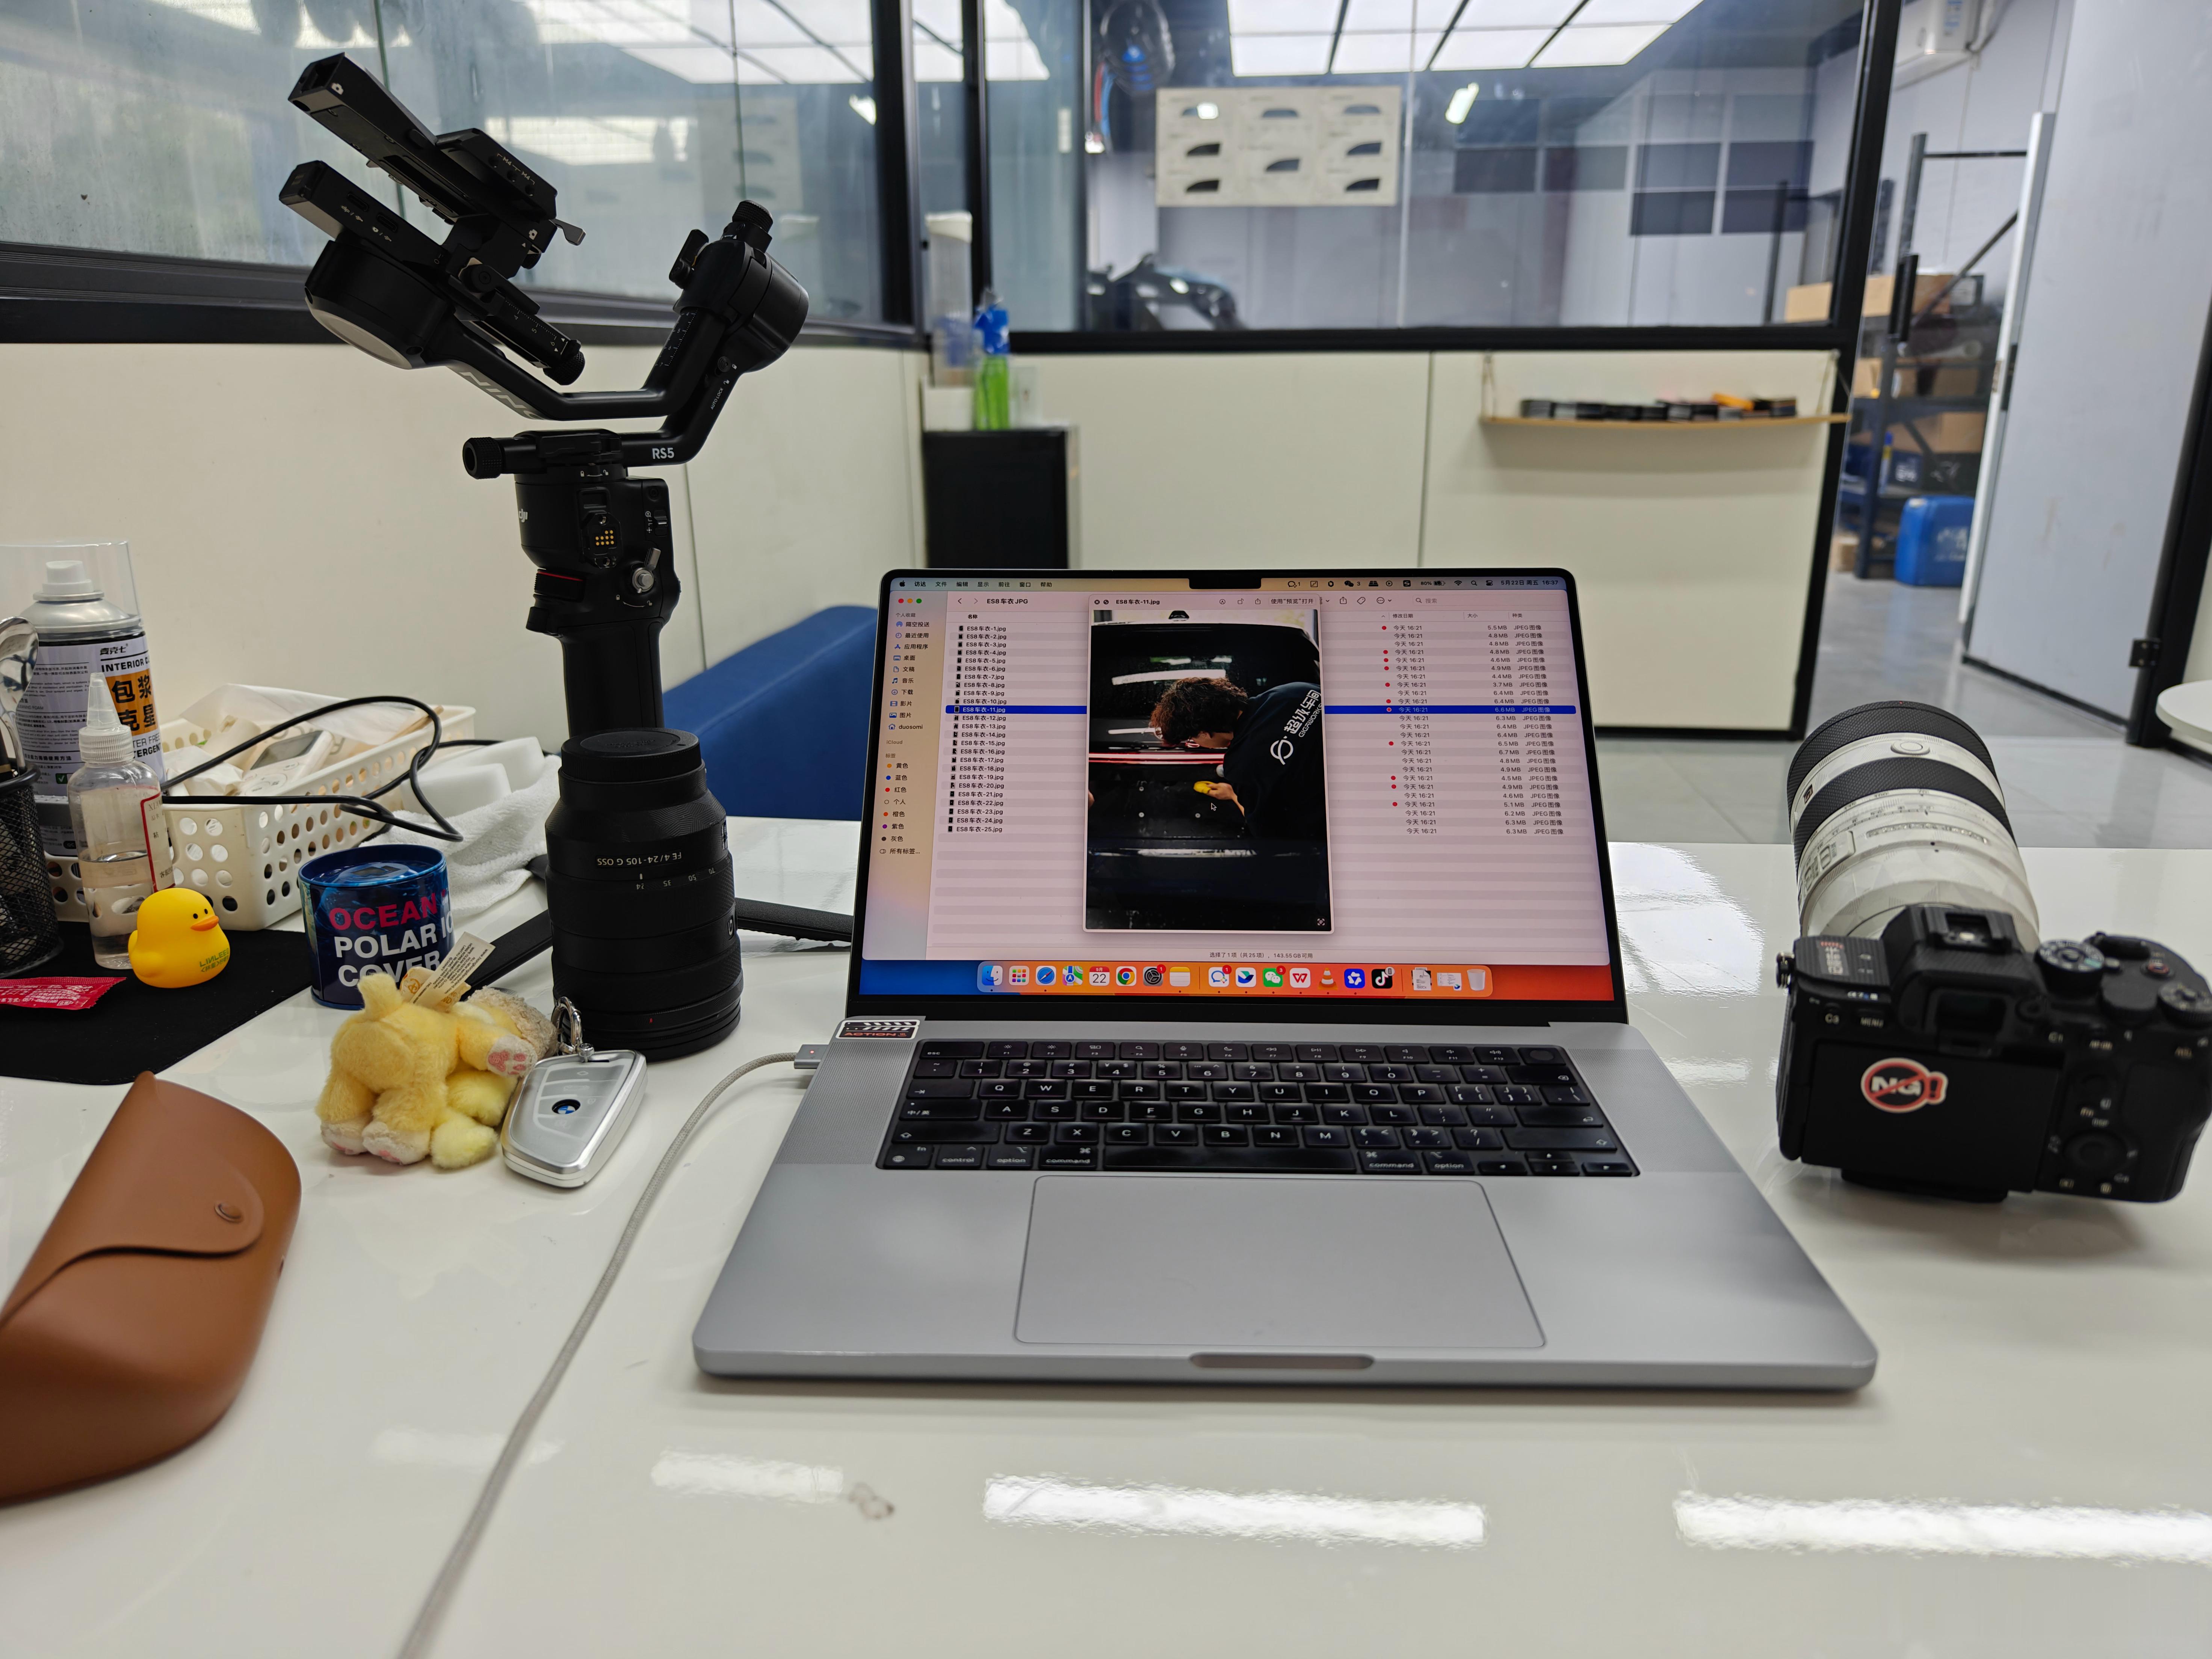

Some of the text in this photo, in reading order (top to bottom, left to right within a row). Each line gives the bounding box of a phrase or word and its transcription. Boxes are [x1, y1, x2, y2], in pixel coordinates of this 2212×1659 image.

[503, 157, 530, 180] M4 M4
[652, 447, 675, 459] RS5
[101, 659, 144, 672] INTERIOR
[329, 893, 438, 931] OCEAN
[334, 923, 438, 958] POLAR
[464, 942, 472, 952] HONG
[457, 951, 465, 961] KONG
[459, 953, 468, 964] CLEAN
[338, 950, 441, 987] COVER
[440, 967, 448, 976] HONG
[432, 976, 441, 985] KONG
[438, 979, 447, 988] CLOTH
[1093, 974, 1106, 983] 22
[1825, 1013, 1840, 1024] C3
